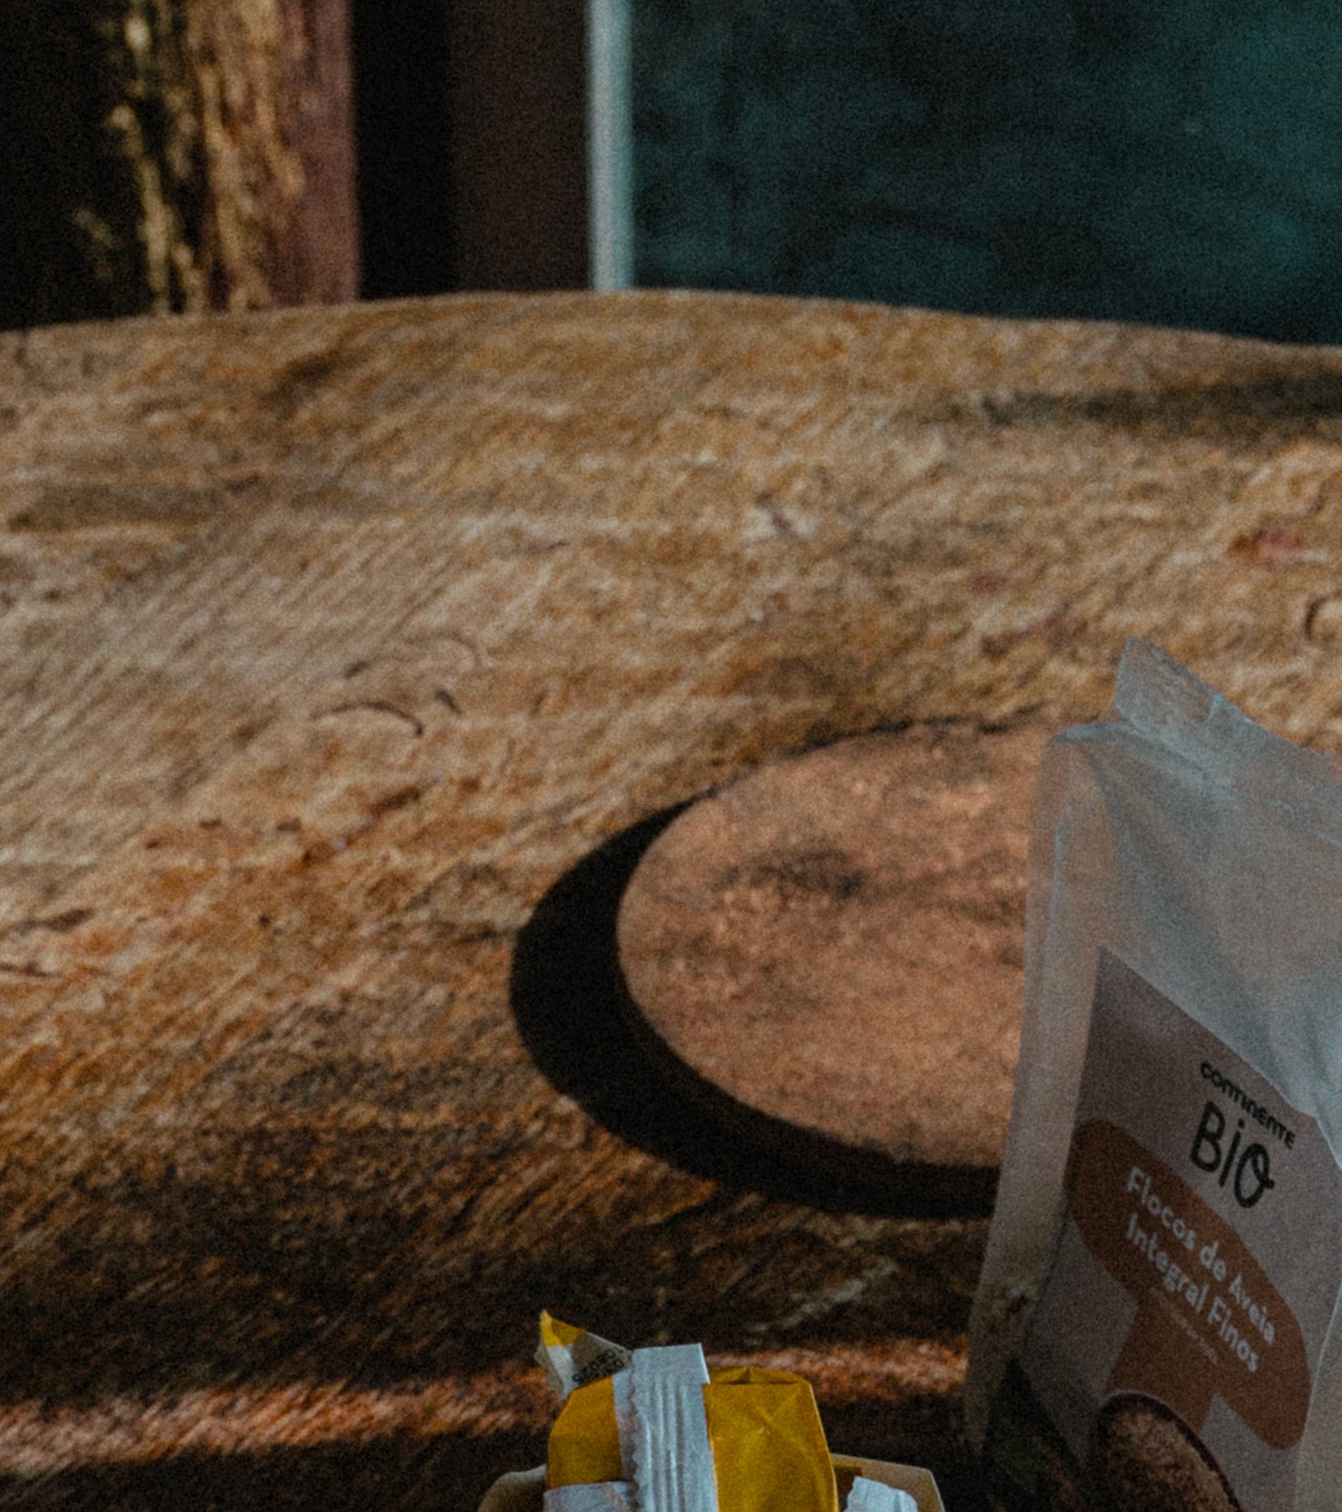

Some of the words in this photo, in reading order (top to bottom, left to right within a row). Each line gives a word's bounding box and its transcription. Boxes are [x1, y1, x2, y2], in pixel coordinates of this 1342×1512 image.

[1200, 1060, 1296, 1150] CONTINENTE
[1126, 1213, 1205, 1318] Integral
[1206, 1299, 1259, 1374] Finos
[1127, 1165, 1197, 1252] Flocos
[1200, 1232, 1228, 1282] de
[1229, 1270, 1277, 1345] Aveia
